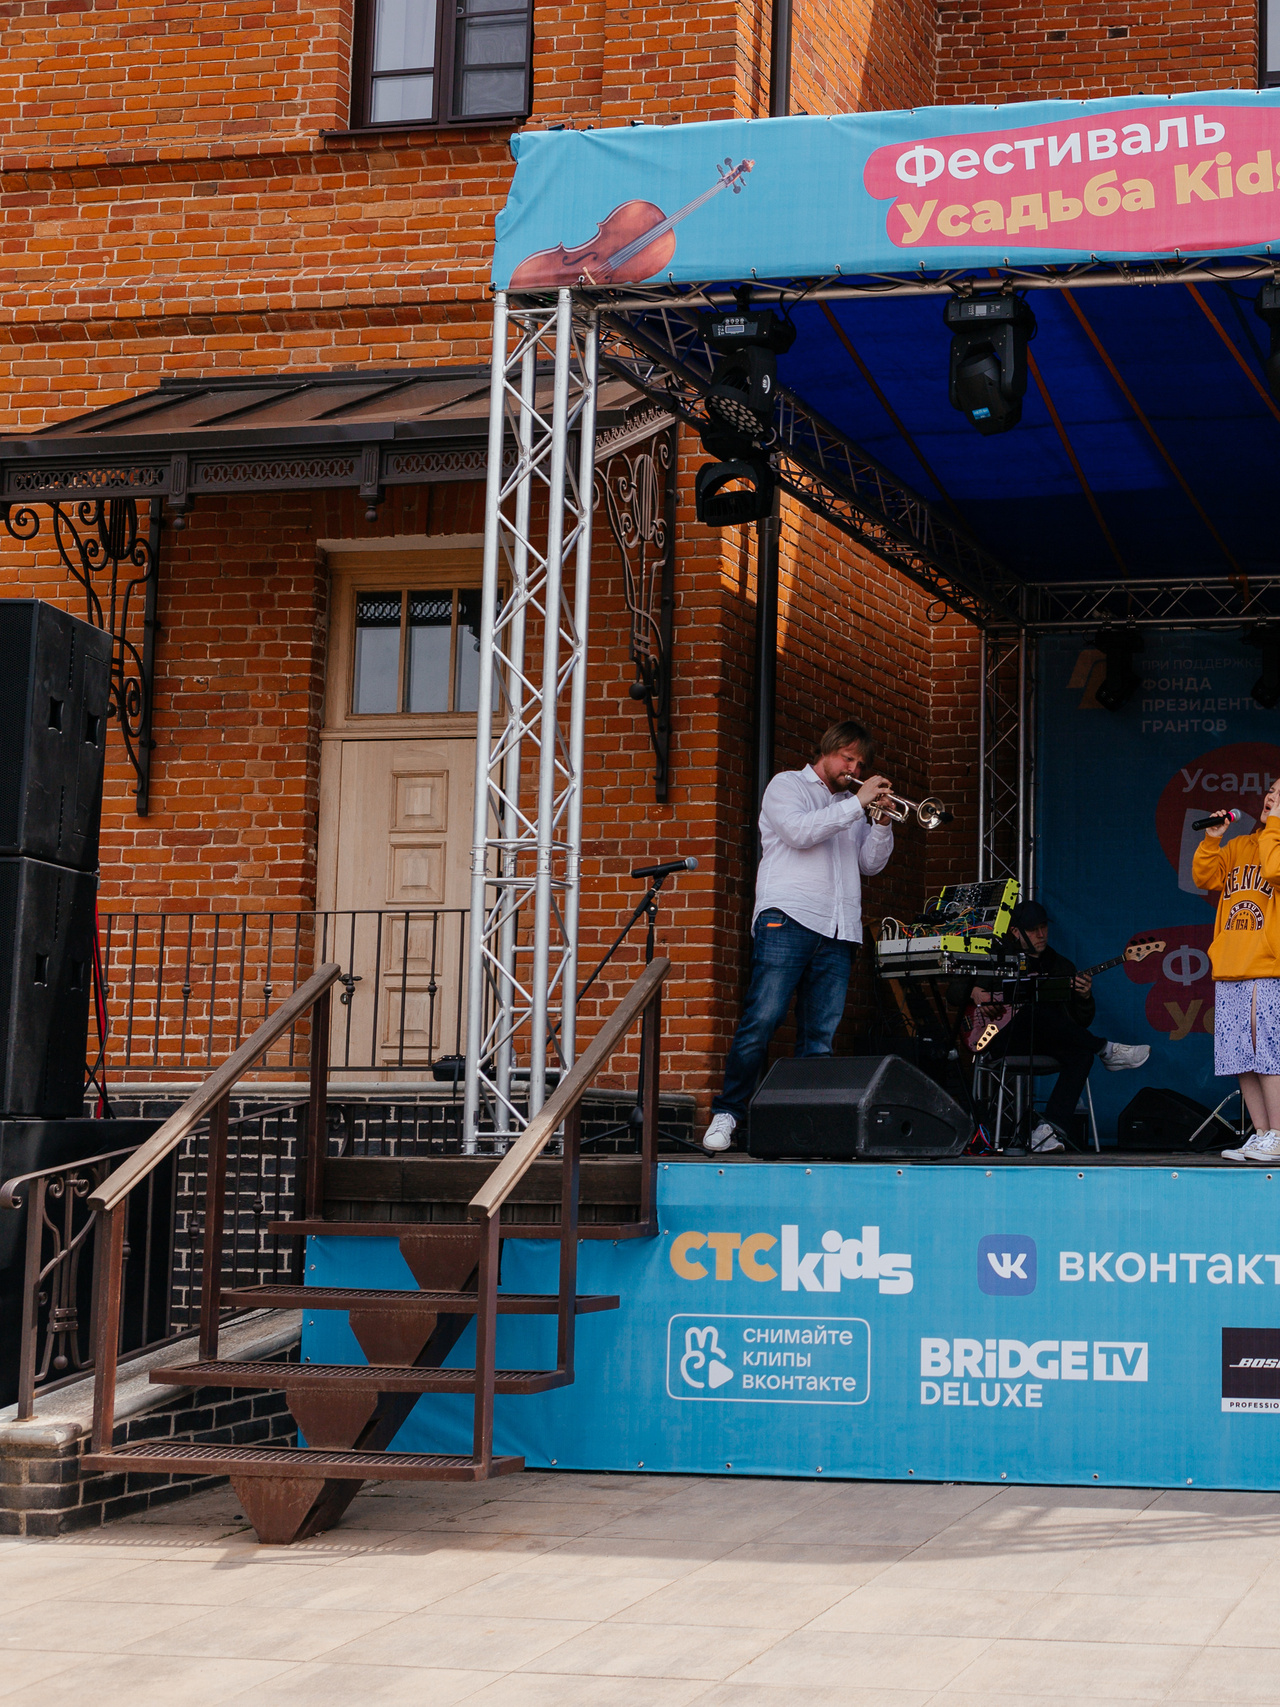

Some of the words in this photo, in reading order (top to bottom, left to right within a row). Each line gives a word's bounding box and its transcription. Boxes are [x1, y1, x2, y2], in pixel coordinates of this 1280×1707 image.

[895, 113, 1226, 188] Фестиваль
[896, 169, 1155, 245] Усадьба
[1142, 660, 1169, 671] ПРИ
[1174, 657, 1263, 671] ПОДДЕРЖКЕ
[1142, 677, 1213, 693] ФОНДА
[1142, 718, 1228, 734] ГРАНТОВ
[987, 1252, 1028, 1280] VK
[743, 1326, 853, 1346] снимайте
[743, 1350, 812, 1369] клипы
[1098, 1346, 1144, 1377] TV
[743, 1373, 857, 1393] вконтакте
[920, 1382, 1043, 1408] DELUXE
